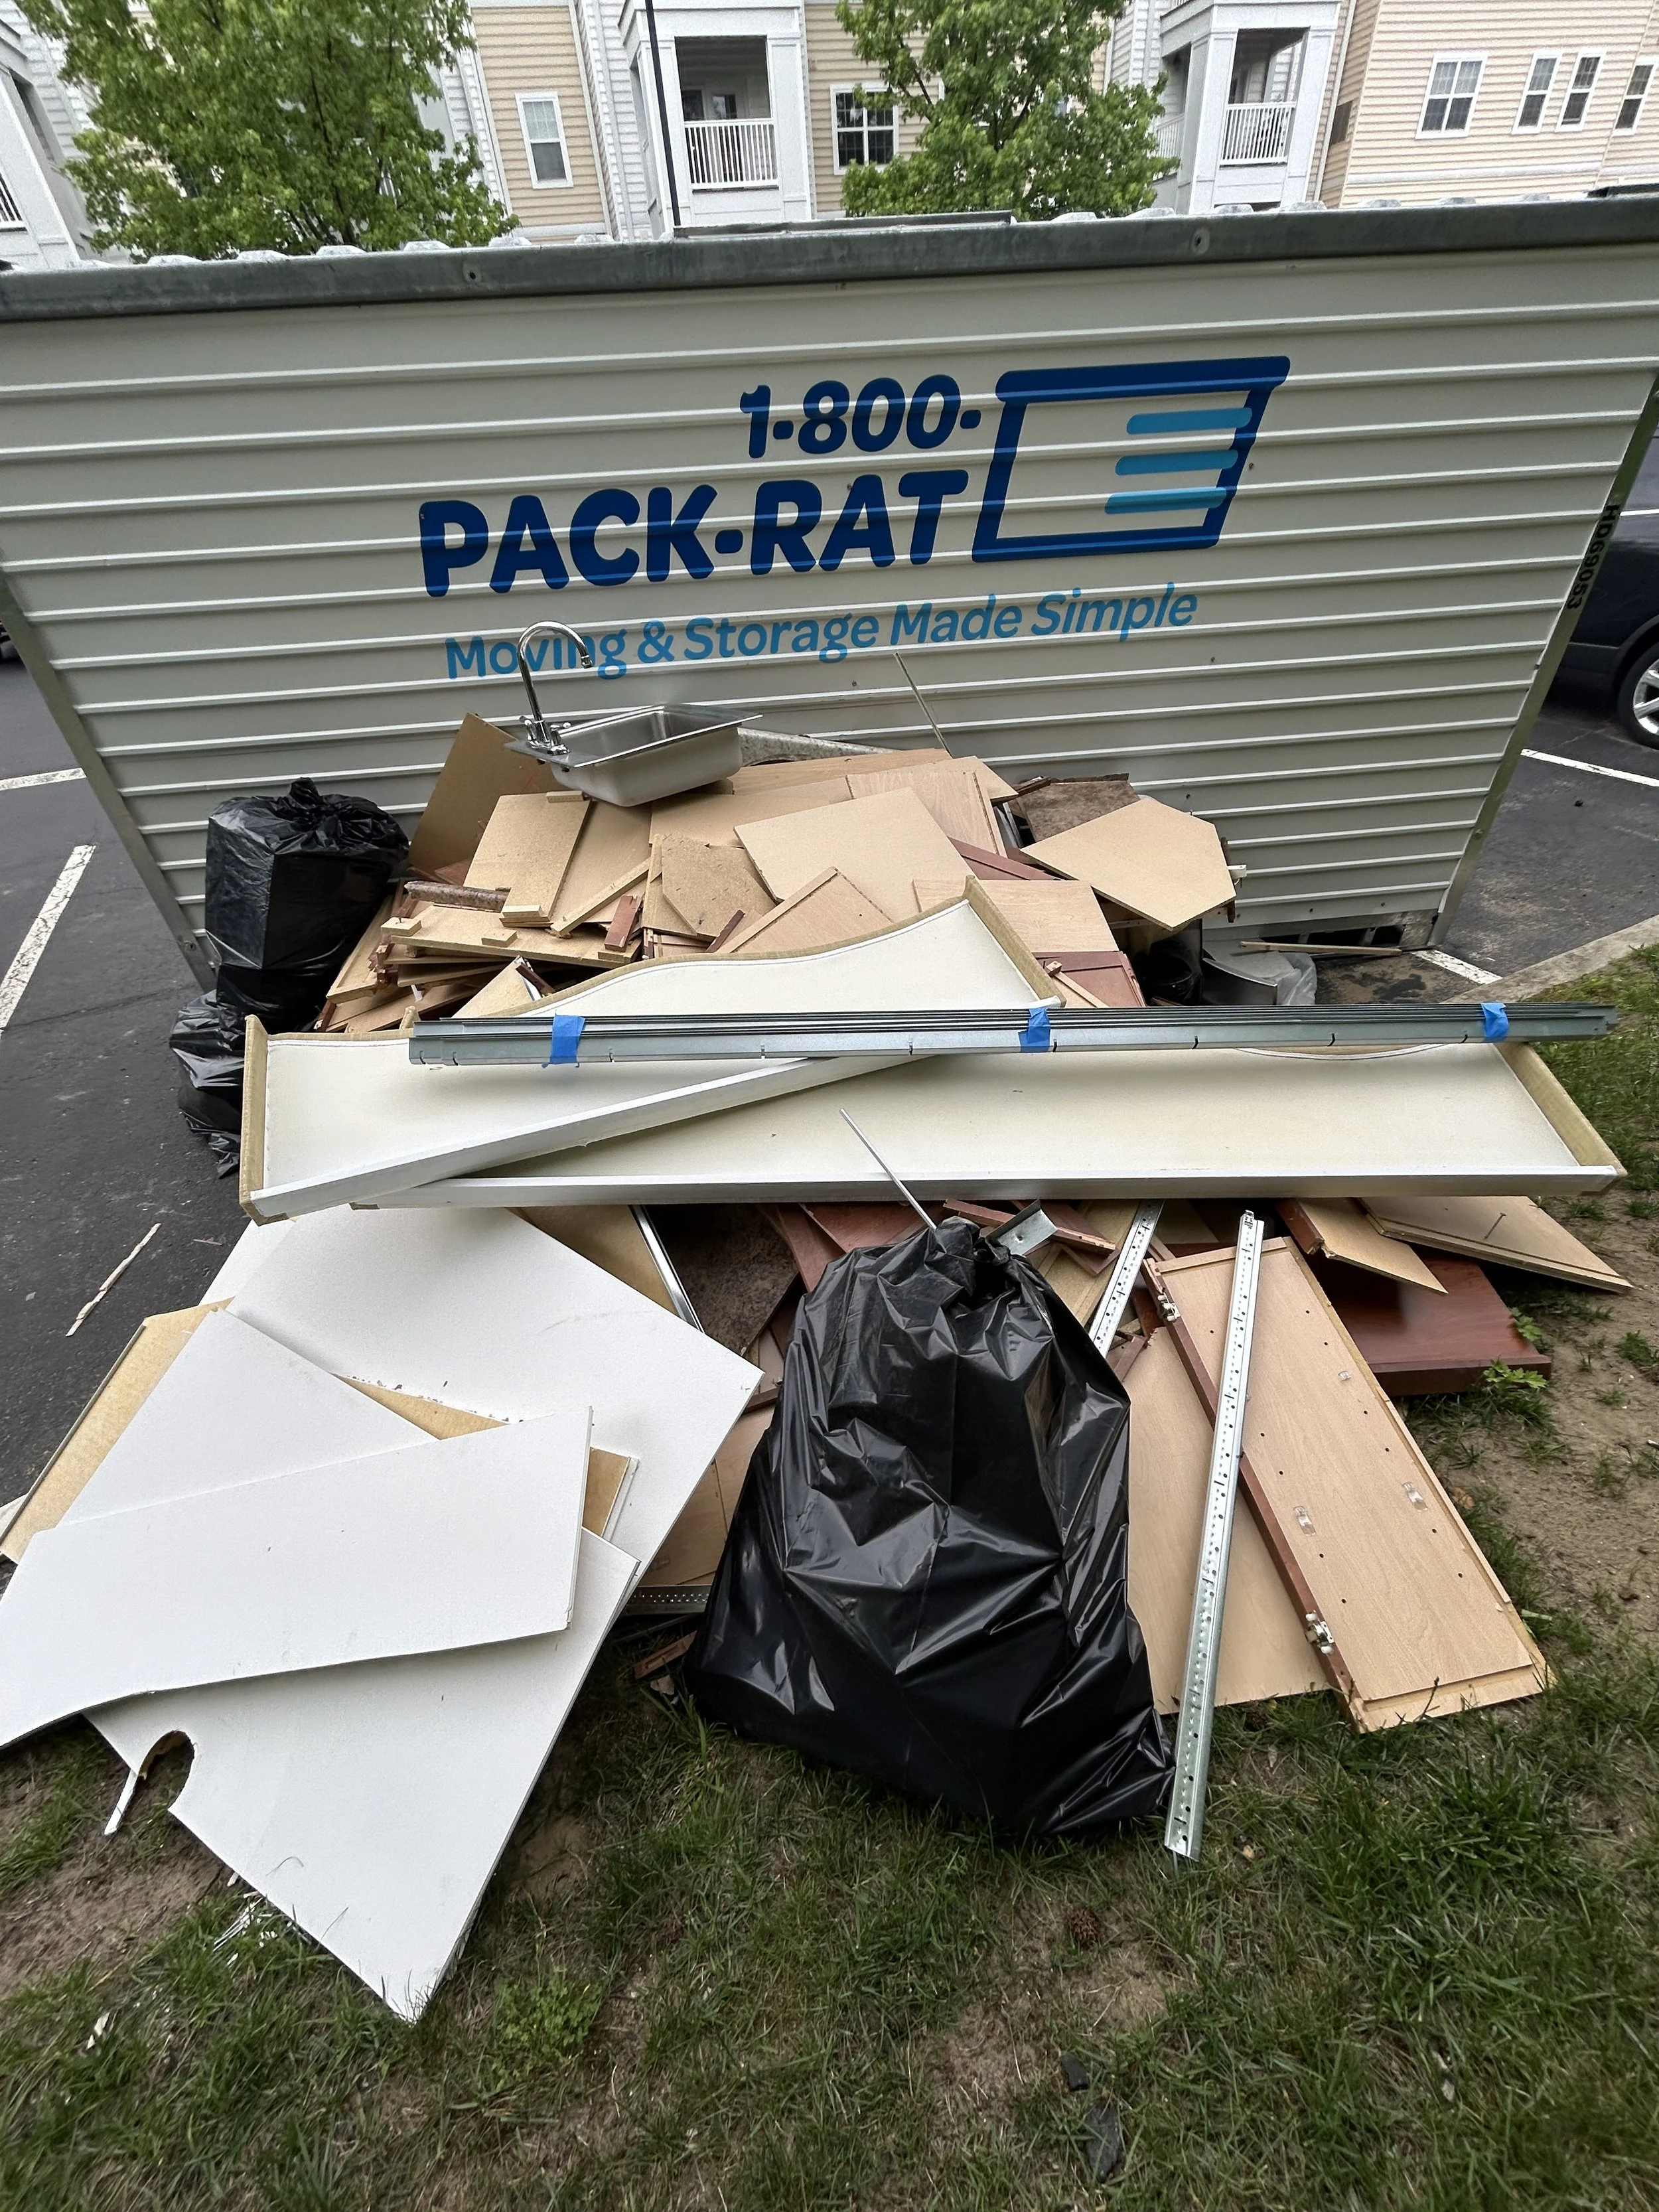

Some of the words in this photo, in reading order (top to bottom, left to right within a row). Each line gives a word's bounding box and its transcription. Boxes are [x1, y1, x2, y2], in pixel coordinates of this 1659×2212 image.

[420, 469, 969, 597] PACK-RAT
[445, 628, 628, 680] Moving
[637, 619, 676, 664] &
[684, 611, 879, 662] Storage
[890, 594, 1023, 646] Made
[1031, 581, 1198, 642] Simple
